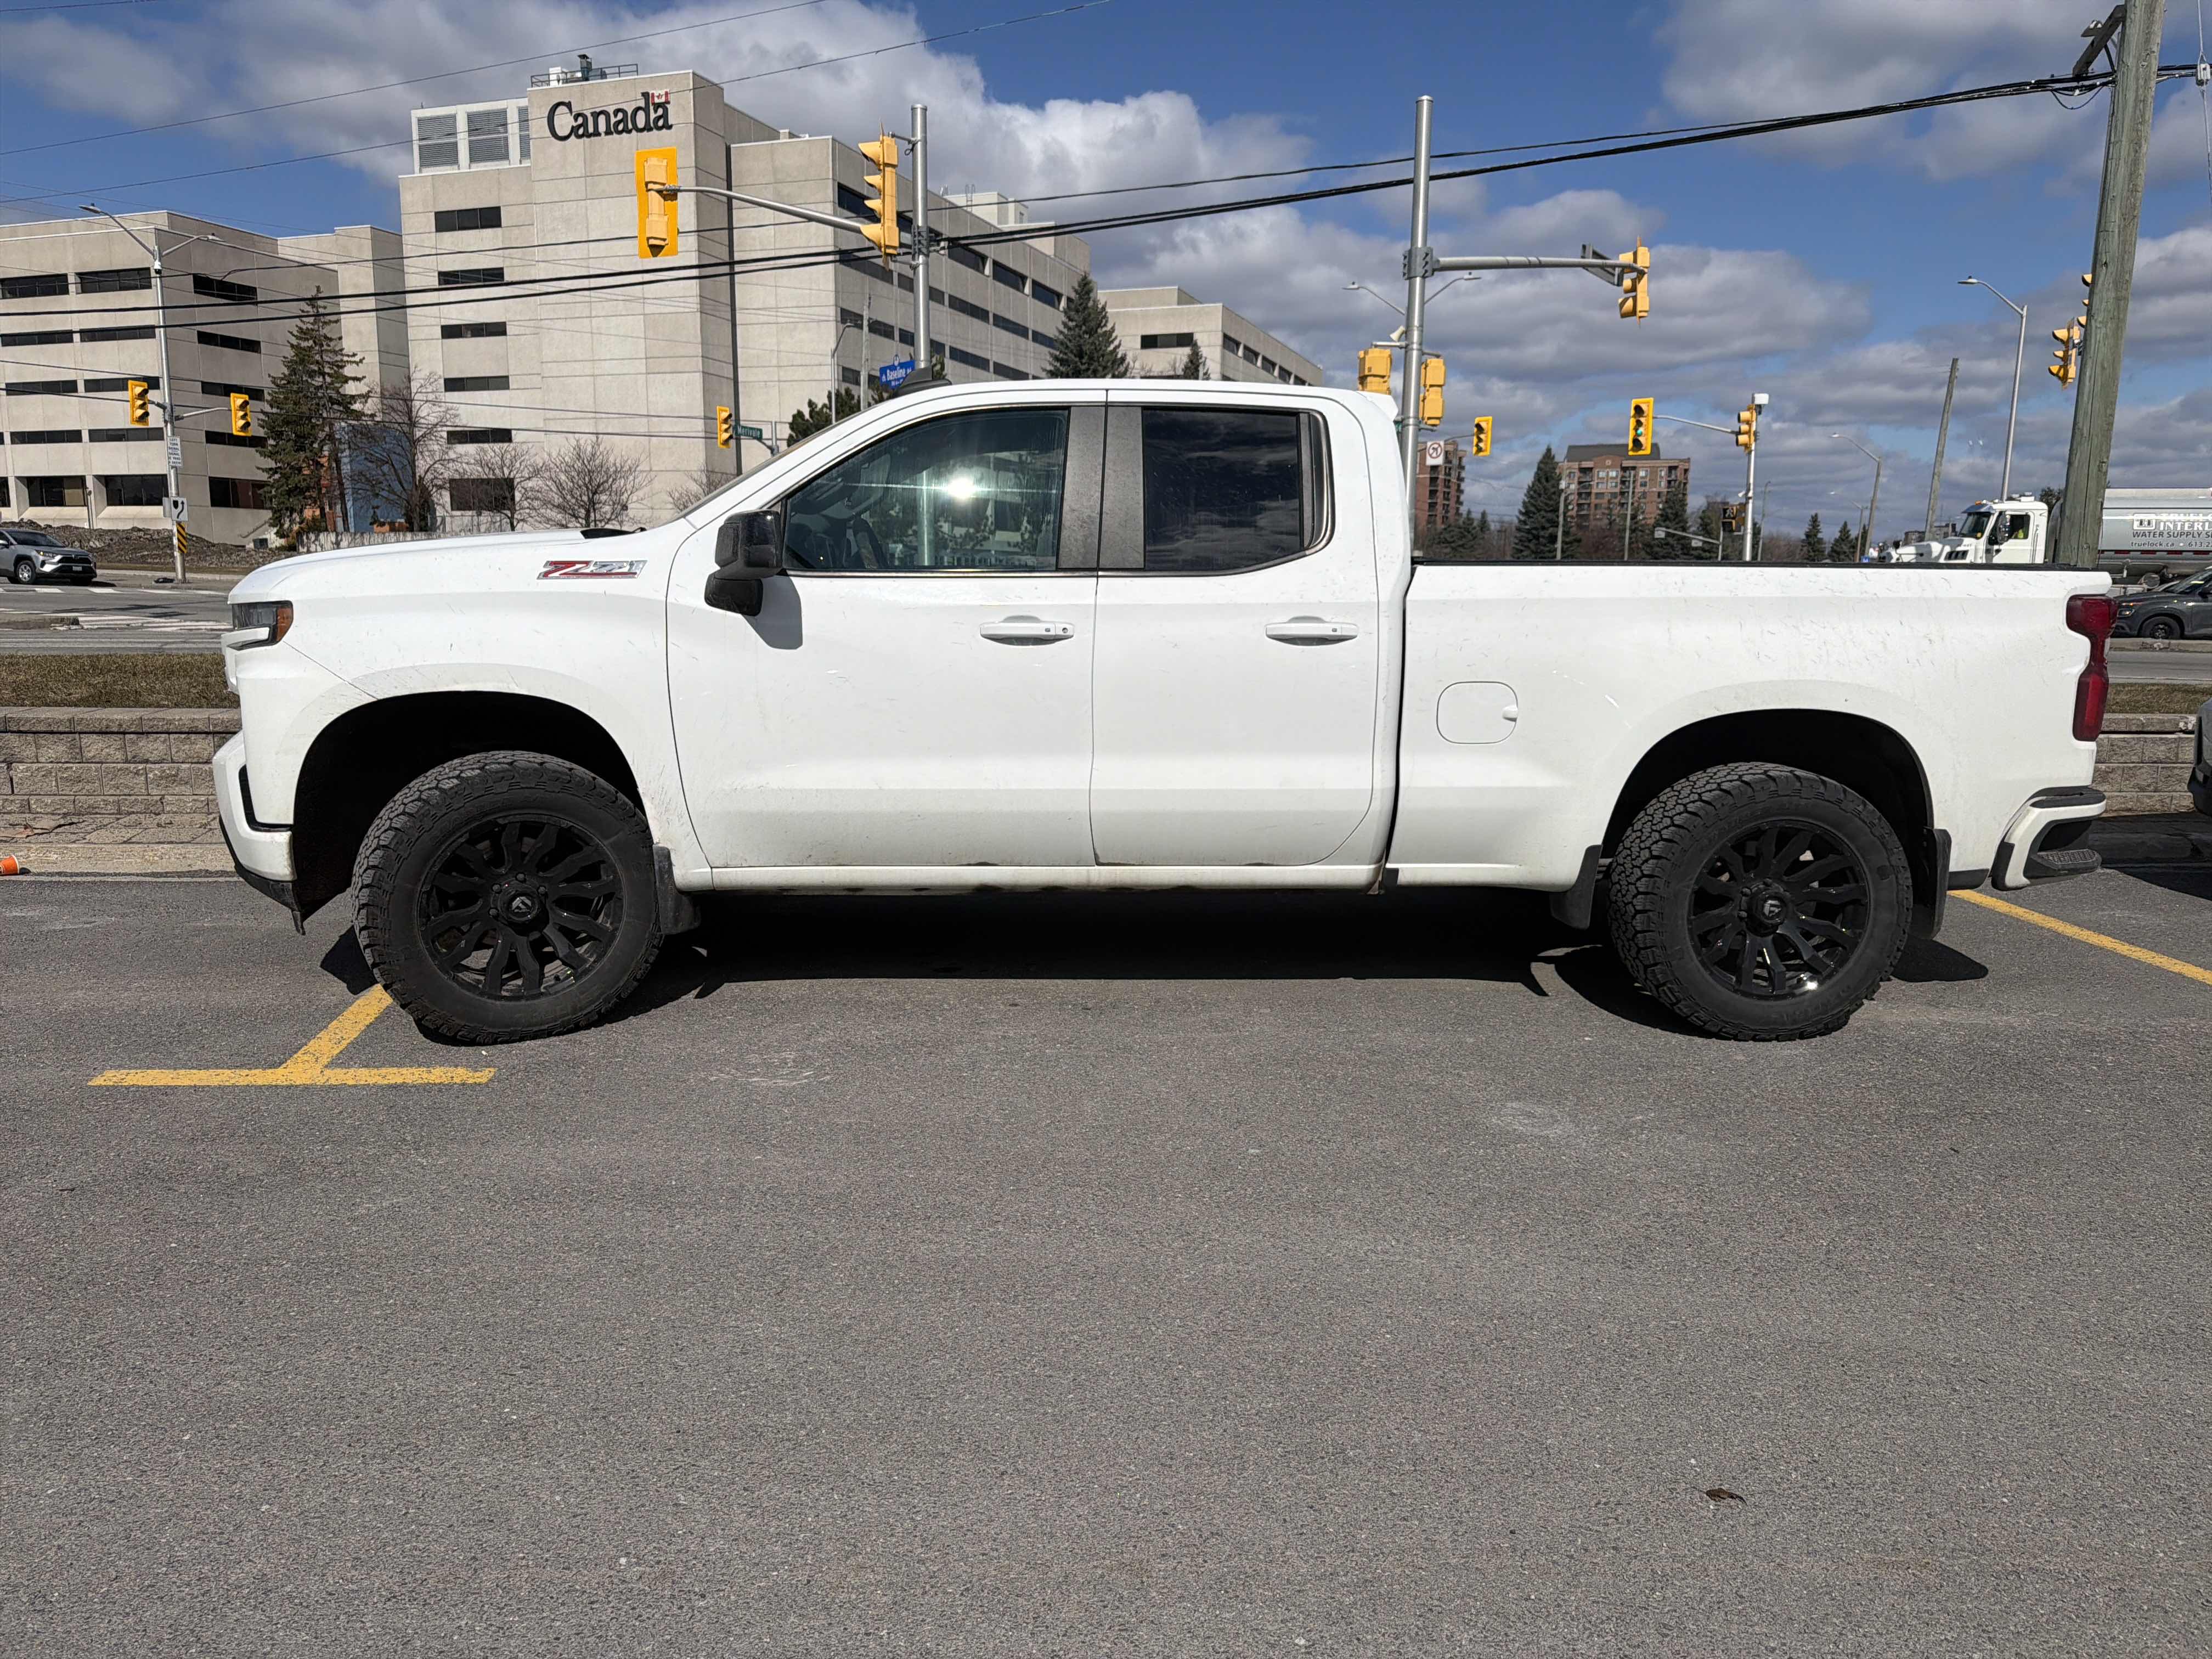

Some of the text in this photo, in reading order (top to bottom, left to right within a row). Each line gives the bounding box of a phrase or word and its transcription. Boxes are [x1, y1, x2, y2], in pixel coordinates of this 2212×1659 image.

[547, 91, 673, 142] Canada
[887, 366, 906, 381] Baseline
[738, 425, 760, 438] Merivale
[537, 560, 648, 580] Z71
